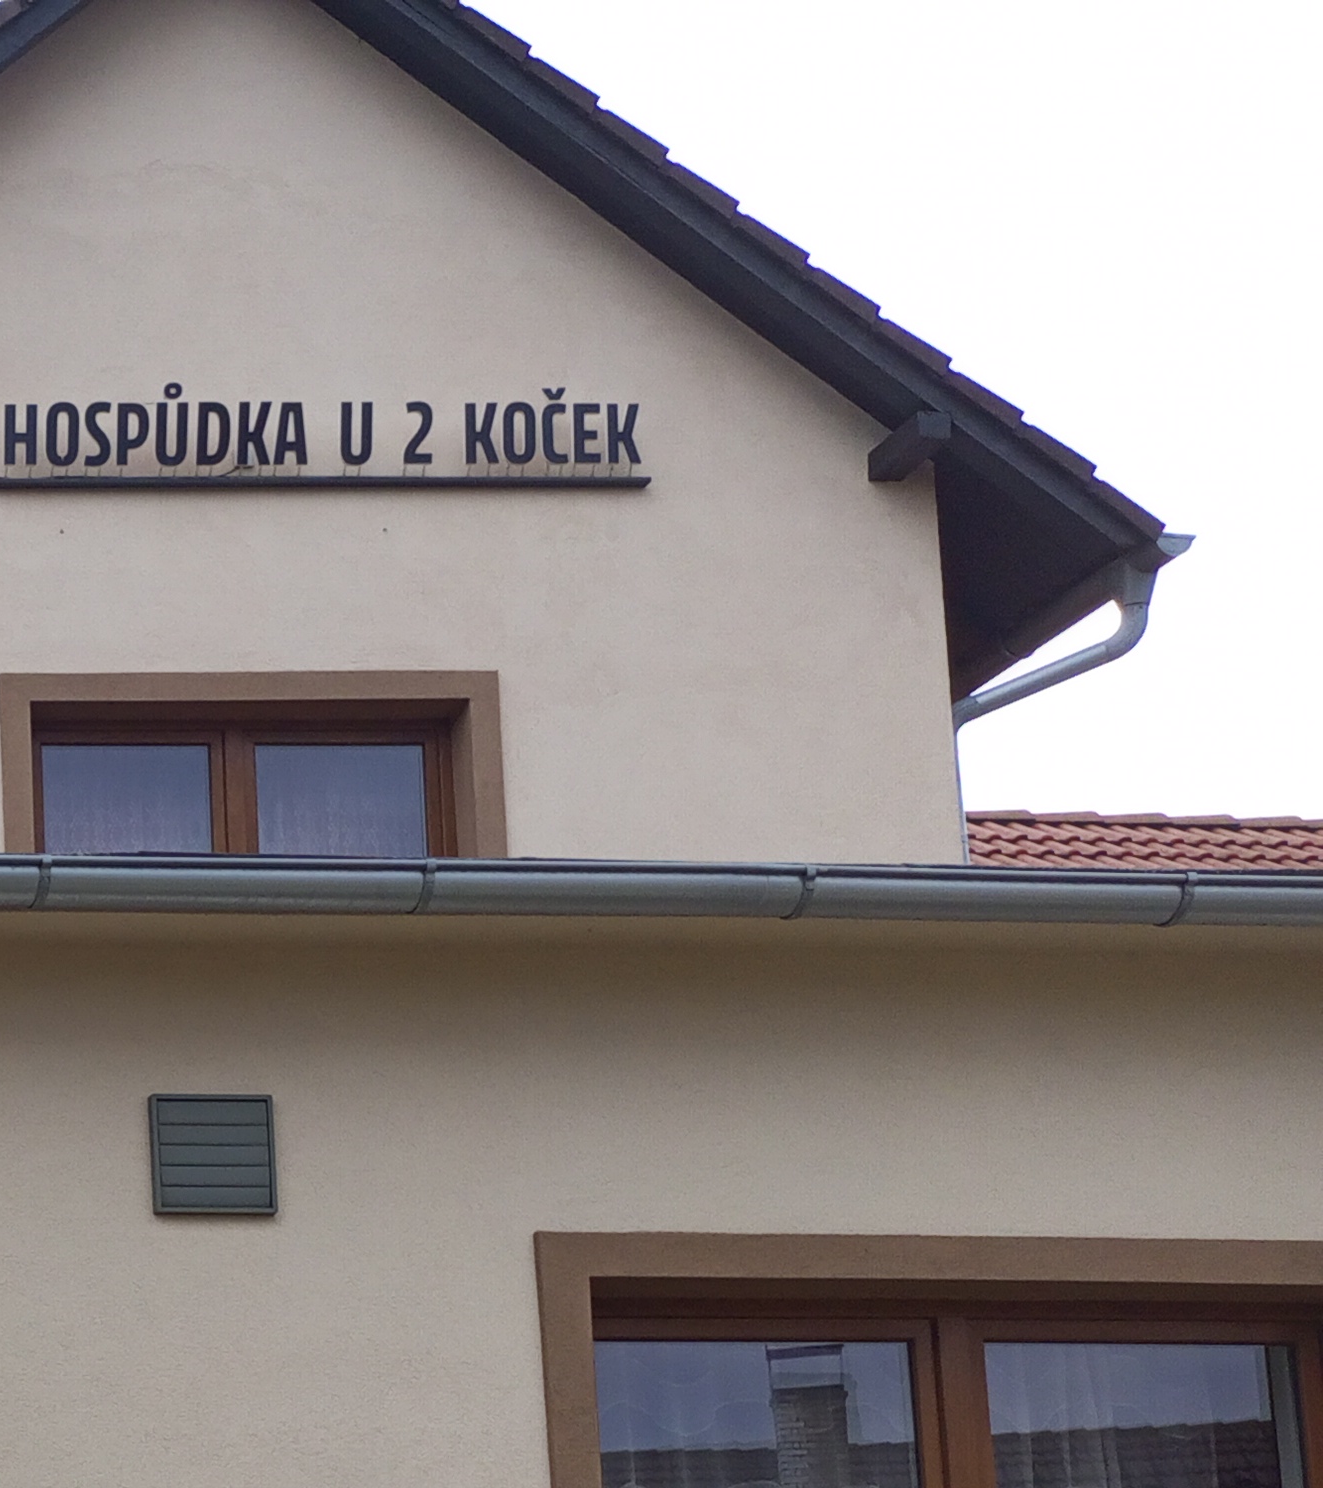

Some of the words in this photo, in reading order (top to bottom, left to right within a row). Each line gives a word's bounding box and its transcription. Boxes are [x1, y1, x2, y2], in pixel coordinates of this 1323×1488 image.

[3, 382, 309, 467] HOSPŮDKA
[340, 400, 373, 466] U
[403, 400, 434, 465] 2
[464, 386, 642, 465] KOČEK
